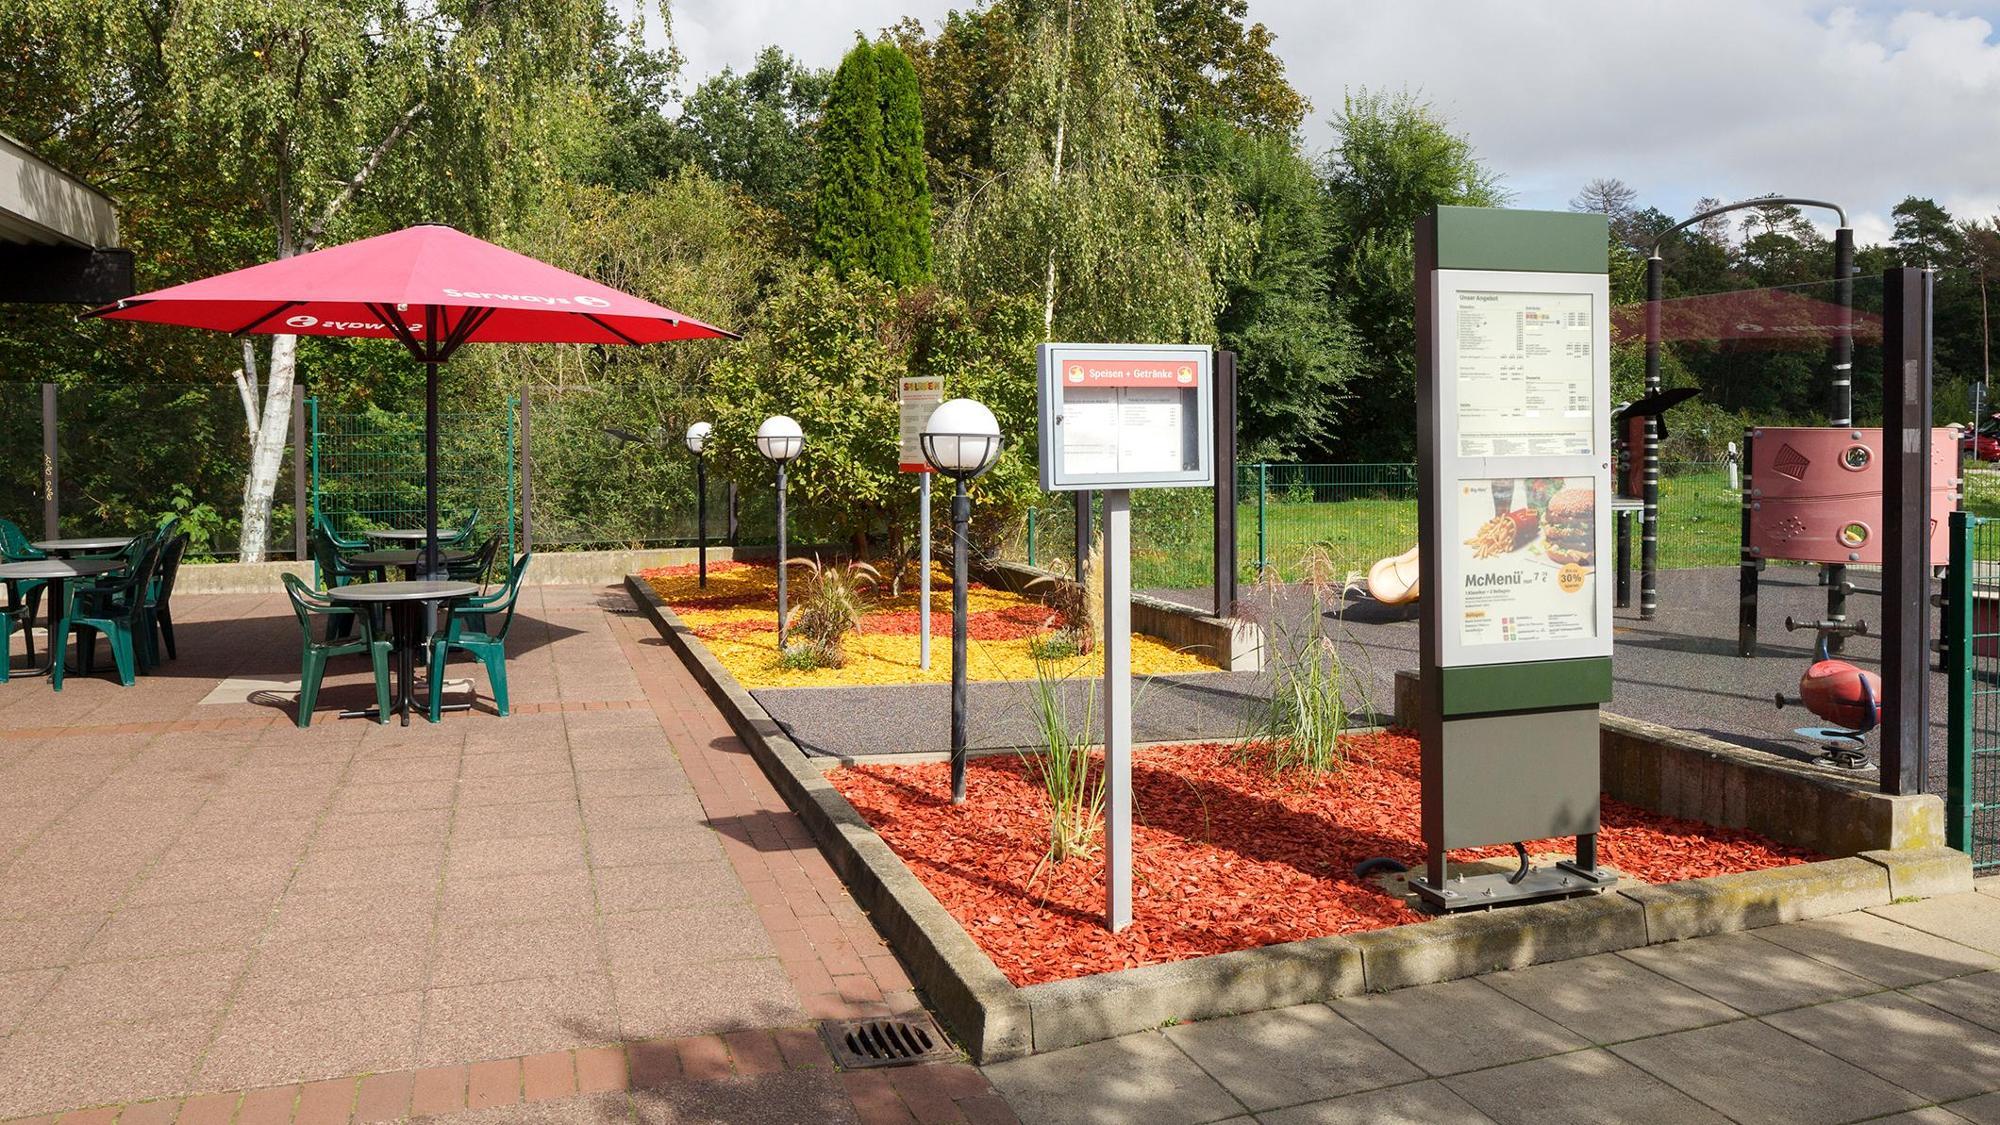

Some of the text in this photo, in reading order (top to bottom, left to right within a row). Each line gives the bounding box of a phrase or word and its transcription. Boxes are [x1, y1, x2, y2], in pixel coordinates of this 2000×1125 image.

[442, 288, 571, 305] Serways
[1089, 368, 1123, 382] Speisen
[1133, 368, 1173, 379] Getränke
[1534, 572, 1539, 581] 7
[1561, 573, 1581, 583] 30%
